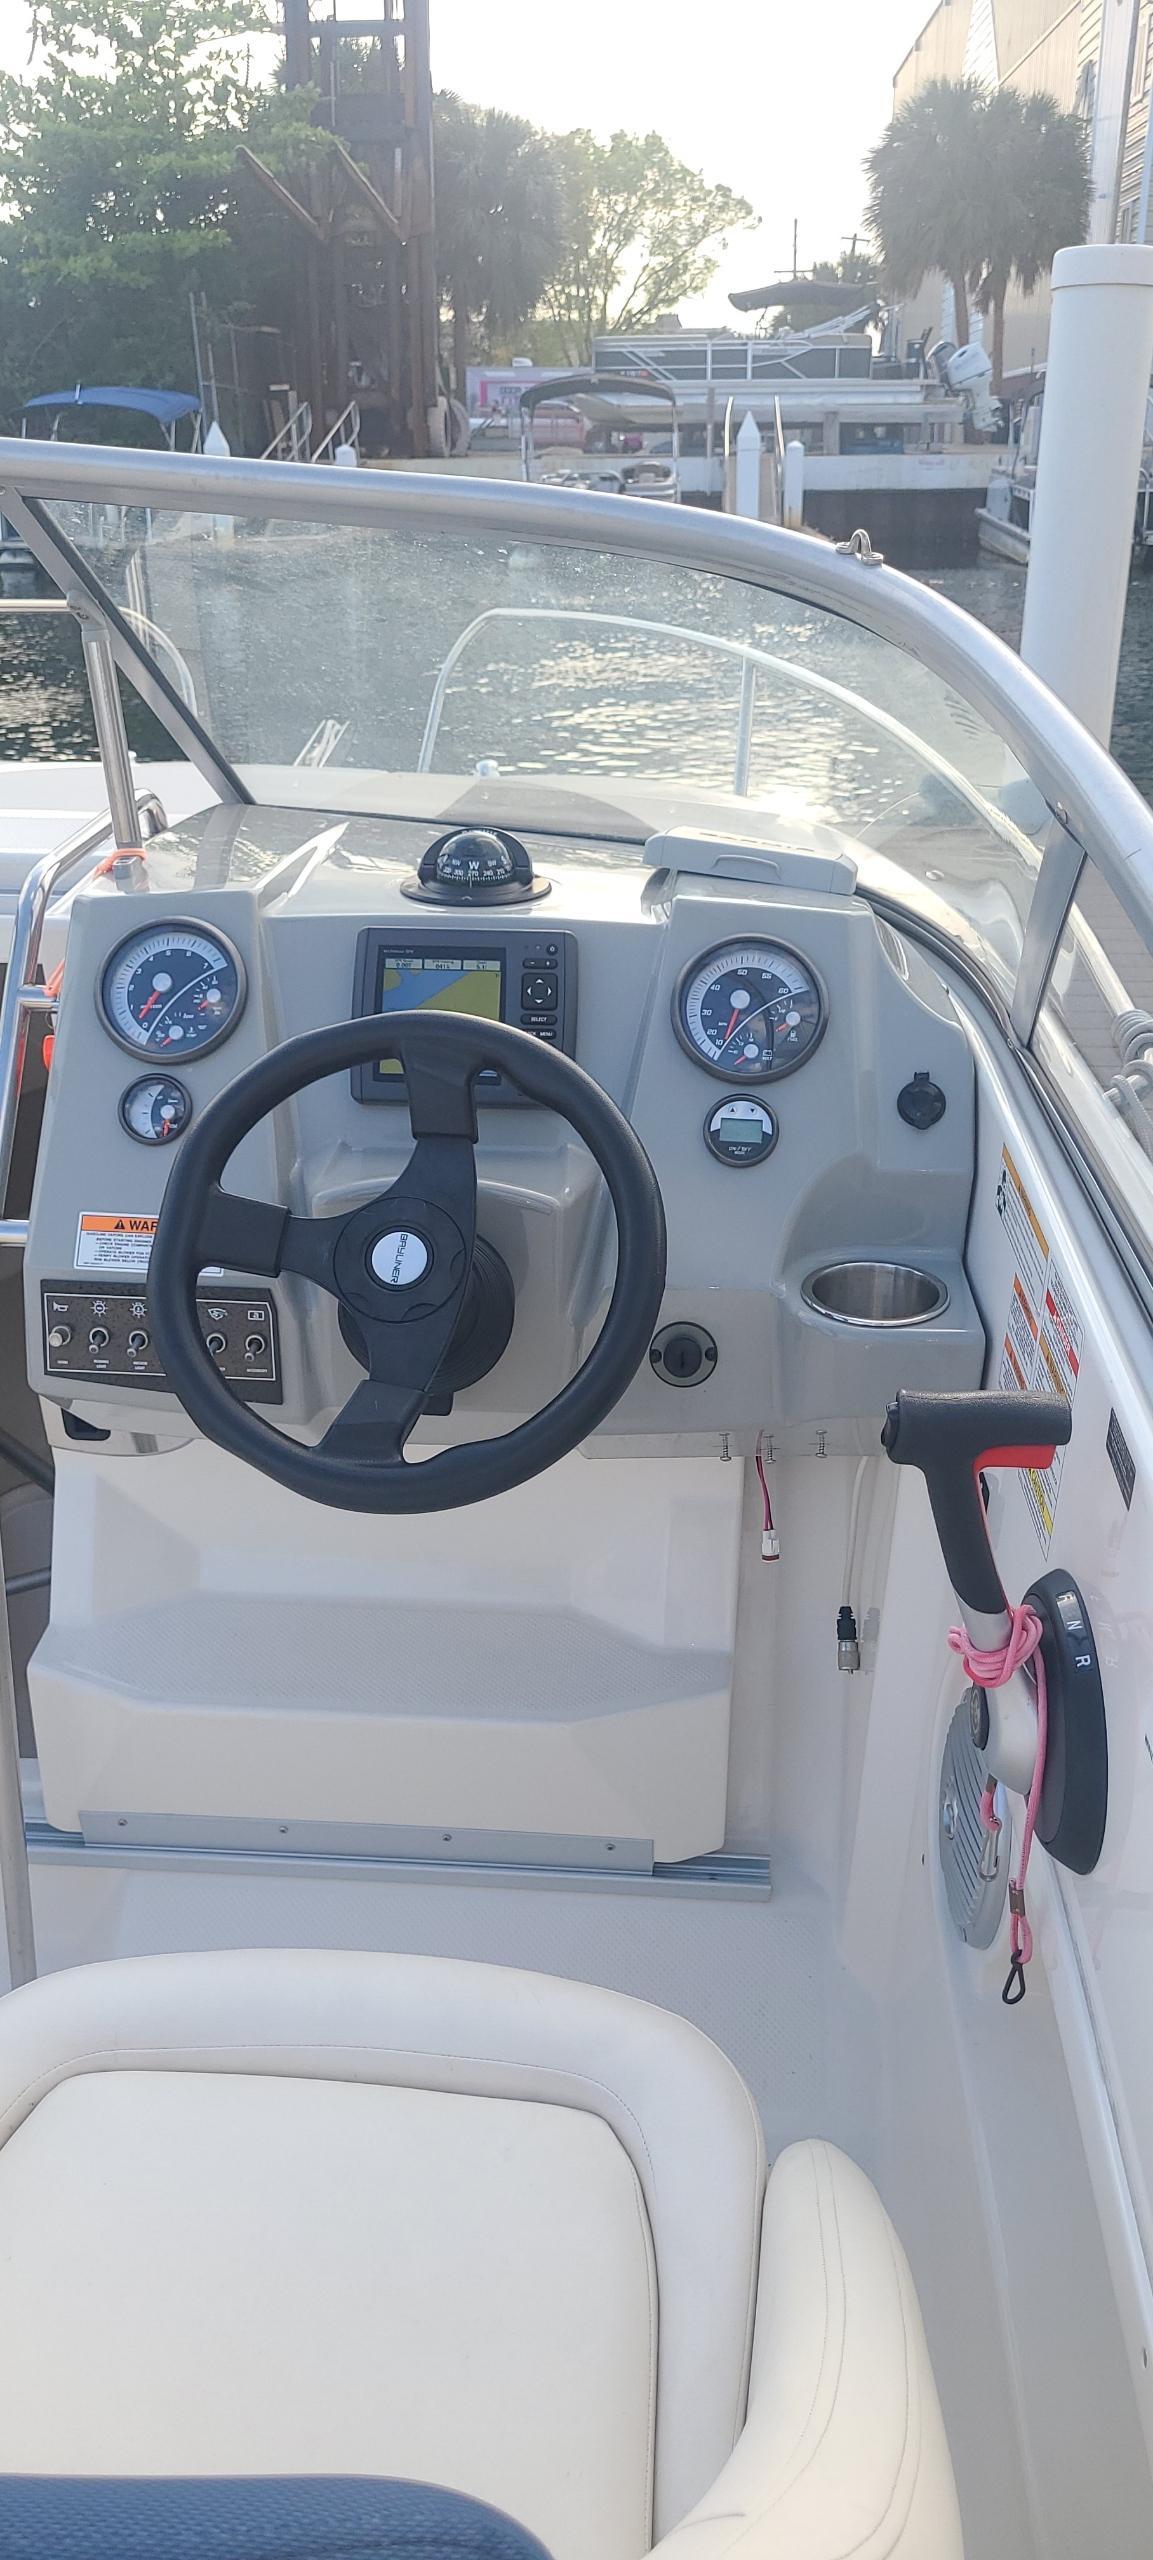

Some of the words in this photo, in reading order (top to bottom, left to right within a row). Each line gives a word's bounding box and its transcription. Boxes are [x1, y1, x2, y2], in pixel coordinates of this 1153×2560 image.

[468, 861, 479, 870] W
[391, 1233, 409, 1284] BAYLINER
[1066, 1621, 1083, 1630] N
[1075, 1655, 1090, 1667] R
